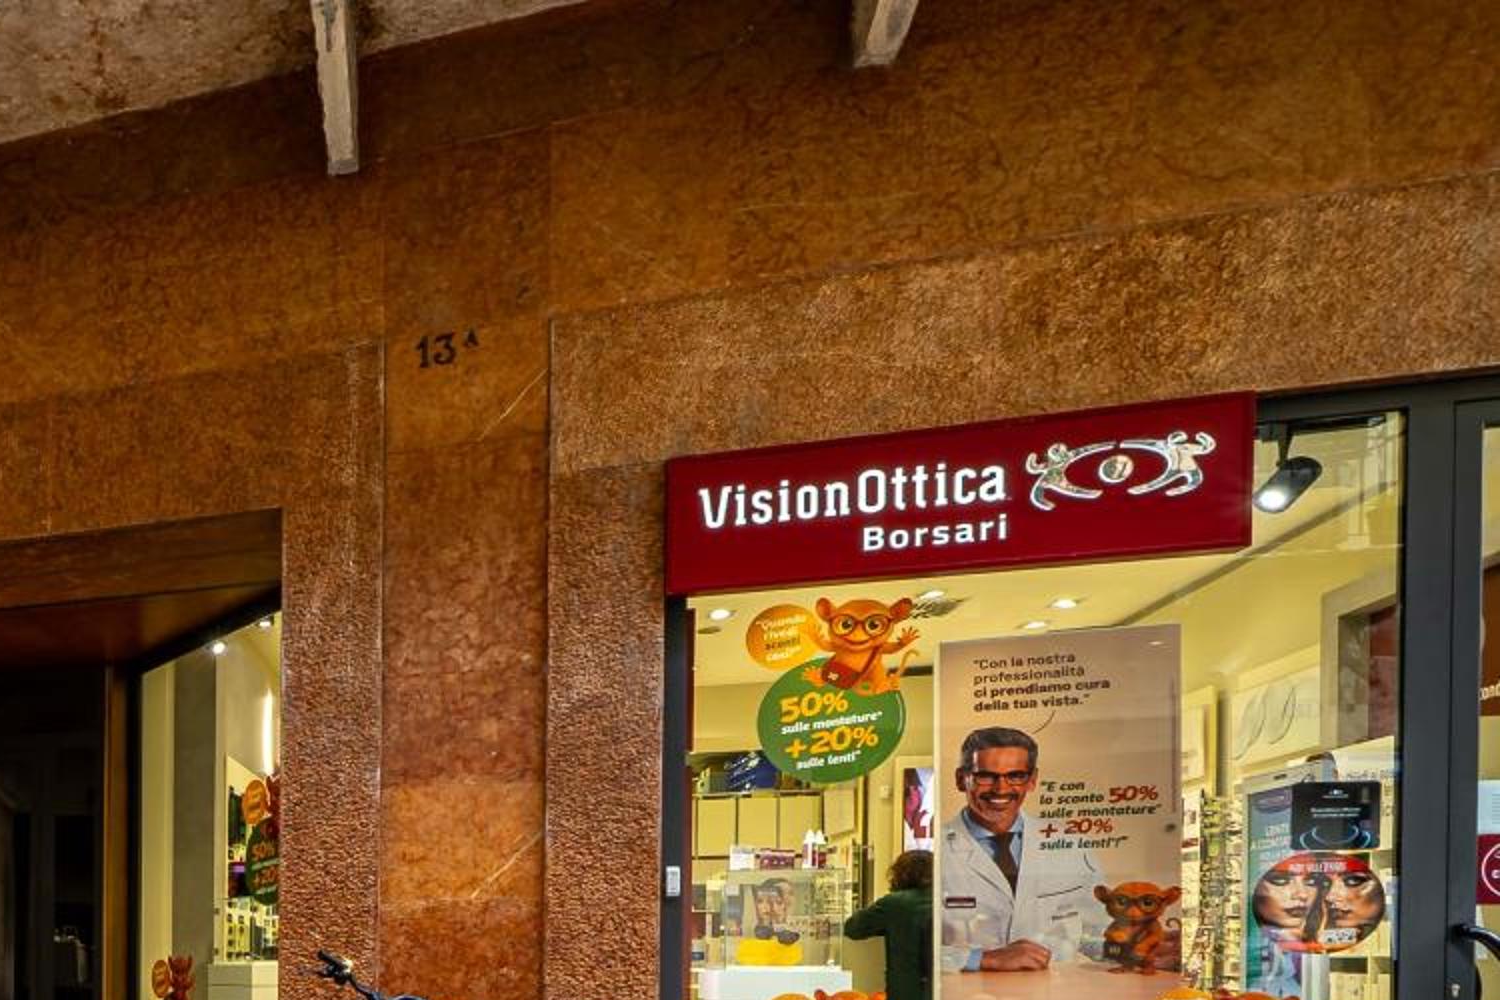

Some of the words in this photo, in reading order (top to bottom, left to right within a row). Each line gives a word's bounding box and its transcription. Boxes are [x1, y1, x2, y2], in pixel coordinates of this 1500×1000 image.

[863, 513, 1008, 551] Borsari
[1011, 656, 1023, 667] la
[1027, 654, 1076, 666] nostra
[974, 687, 987, 698] ci
[990, 680, 1072, 698] prendiamo
[1075, 680, 1111, 690] cura
[781, 690, 849, 723] 50%
[974, 700, 1010, 712] della
[1013, 699, 1038, 709] tua
[781, 721, 810, 735] sulle
[796, 757, 825, 770] sulle
[1059, 781, 1085, 791] con
[1040, 793, 1053, 805] lo
[1057, 793, 1105, 805] sconto
[1108, 785, 1159, 804] 50%
[1040, 806, 1073, 818] sulle
[1040, 837, 1074, 850] sulle
